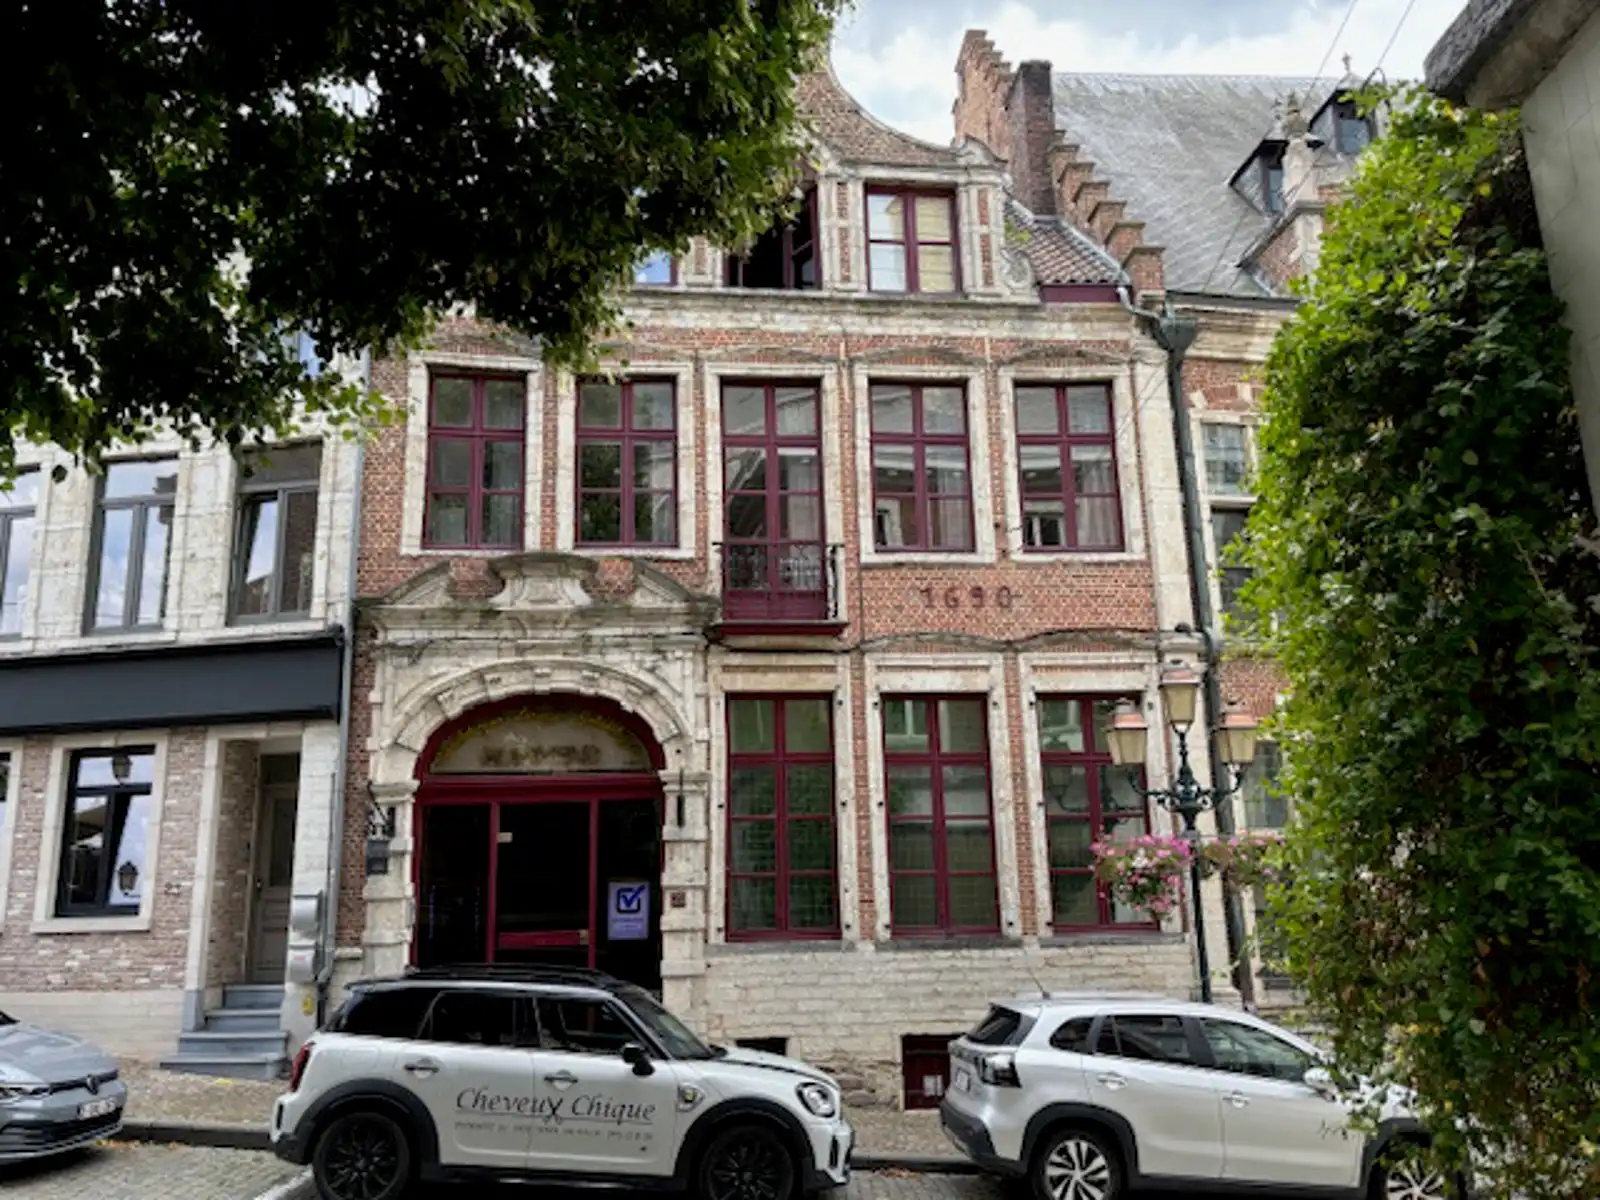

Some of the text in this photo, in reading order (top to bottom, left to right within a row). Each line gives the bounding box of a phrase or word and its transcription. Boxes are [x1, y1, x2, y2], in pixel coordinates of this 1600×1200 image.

[920, 584, 1012, 609] 1690
[456, 1086, 656, 1125] Cheveux Chique
